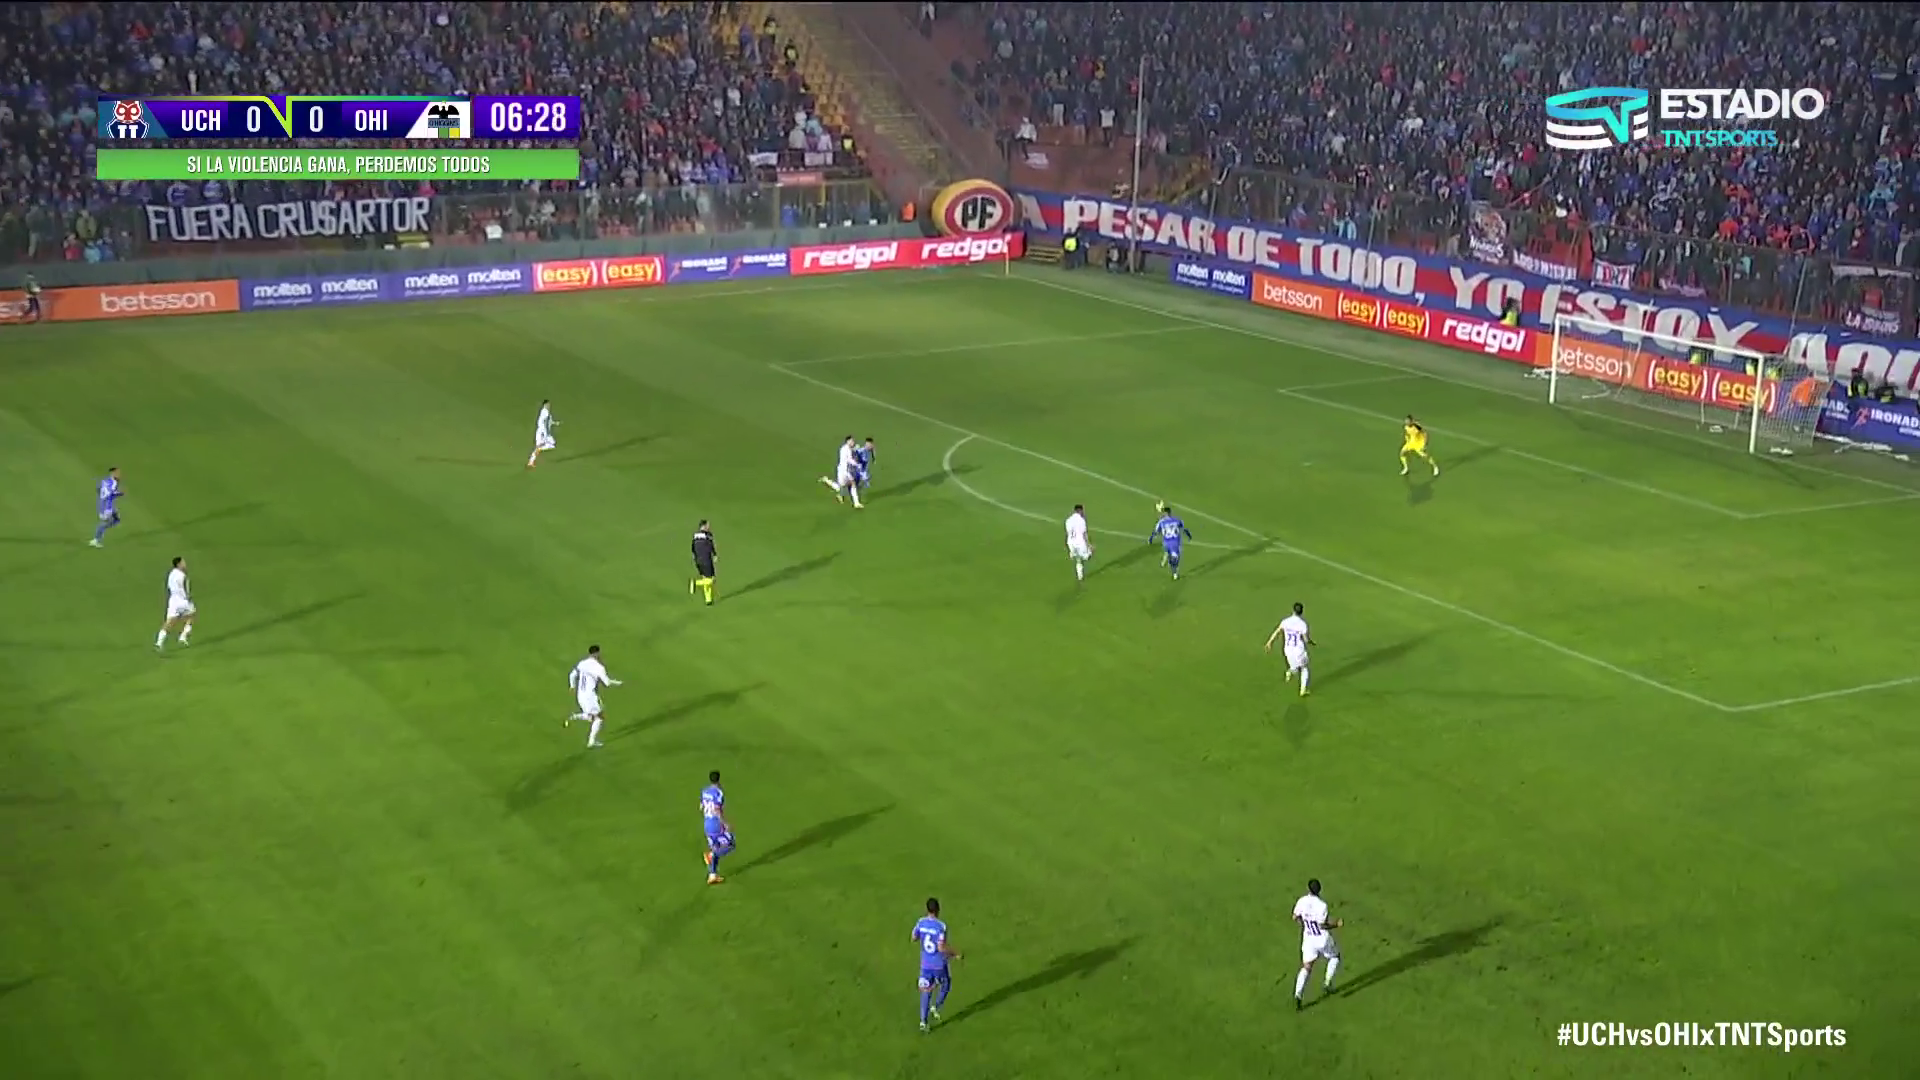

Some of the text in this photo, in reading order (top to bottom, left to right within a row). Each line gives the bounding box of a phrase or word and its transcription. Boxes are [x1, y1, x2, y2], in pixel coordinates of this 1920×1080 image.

[147, 203, 253, 241] FUERA
[961, 196, 997, 231] PF
[803, 242, 898, 269] redgol
[921, 235, 1011, 261] redgol
[253, 283, 312, 298] molten
[321, 278, 378, 293] molten
[405, 272, 459, 289] molten
[467, 268, 521, 284] molten
[1063, 199, 1216, 255] PESAR
[1227, 225, 1282, 269] DE
[1449, 266, 1525, 317] YO
[1540, 284, 1760, 362] ESTOY
[101, 291, 216, 312] betsson
[1263, 280, 1323, 311] betsson
[1442, 317, 1526, 353] redgol
[1871, 408, 1920, 428] IRONAD
[1304, 919, 1322, 936] 10
[924, 934, 936, 954] 6
